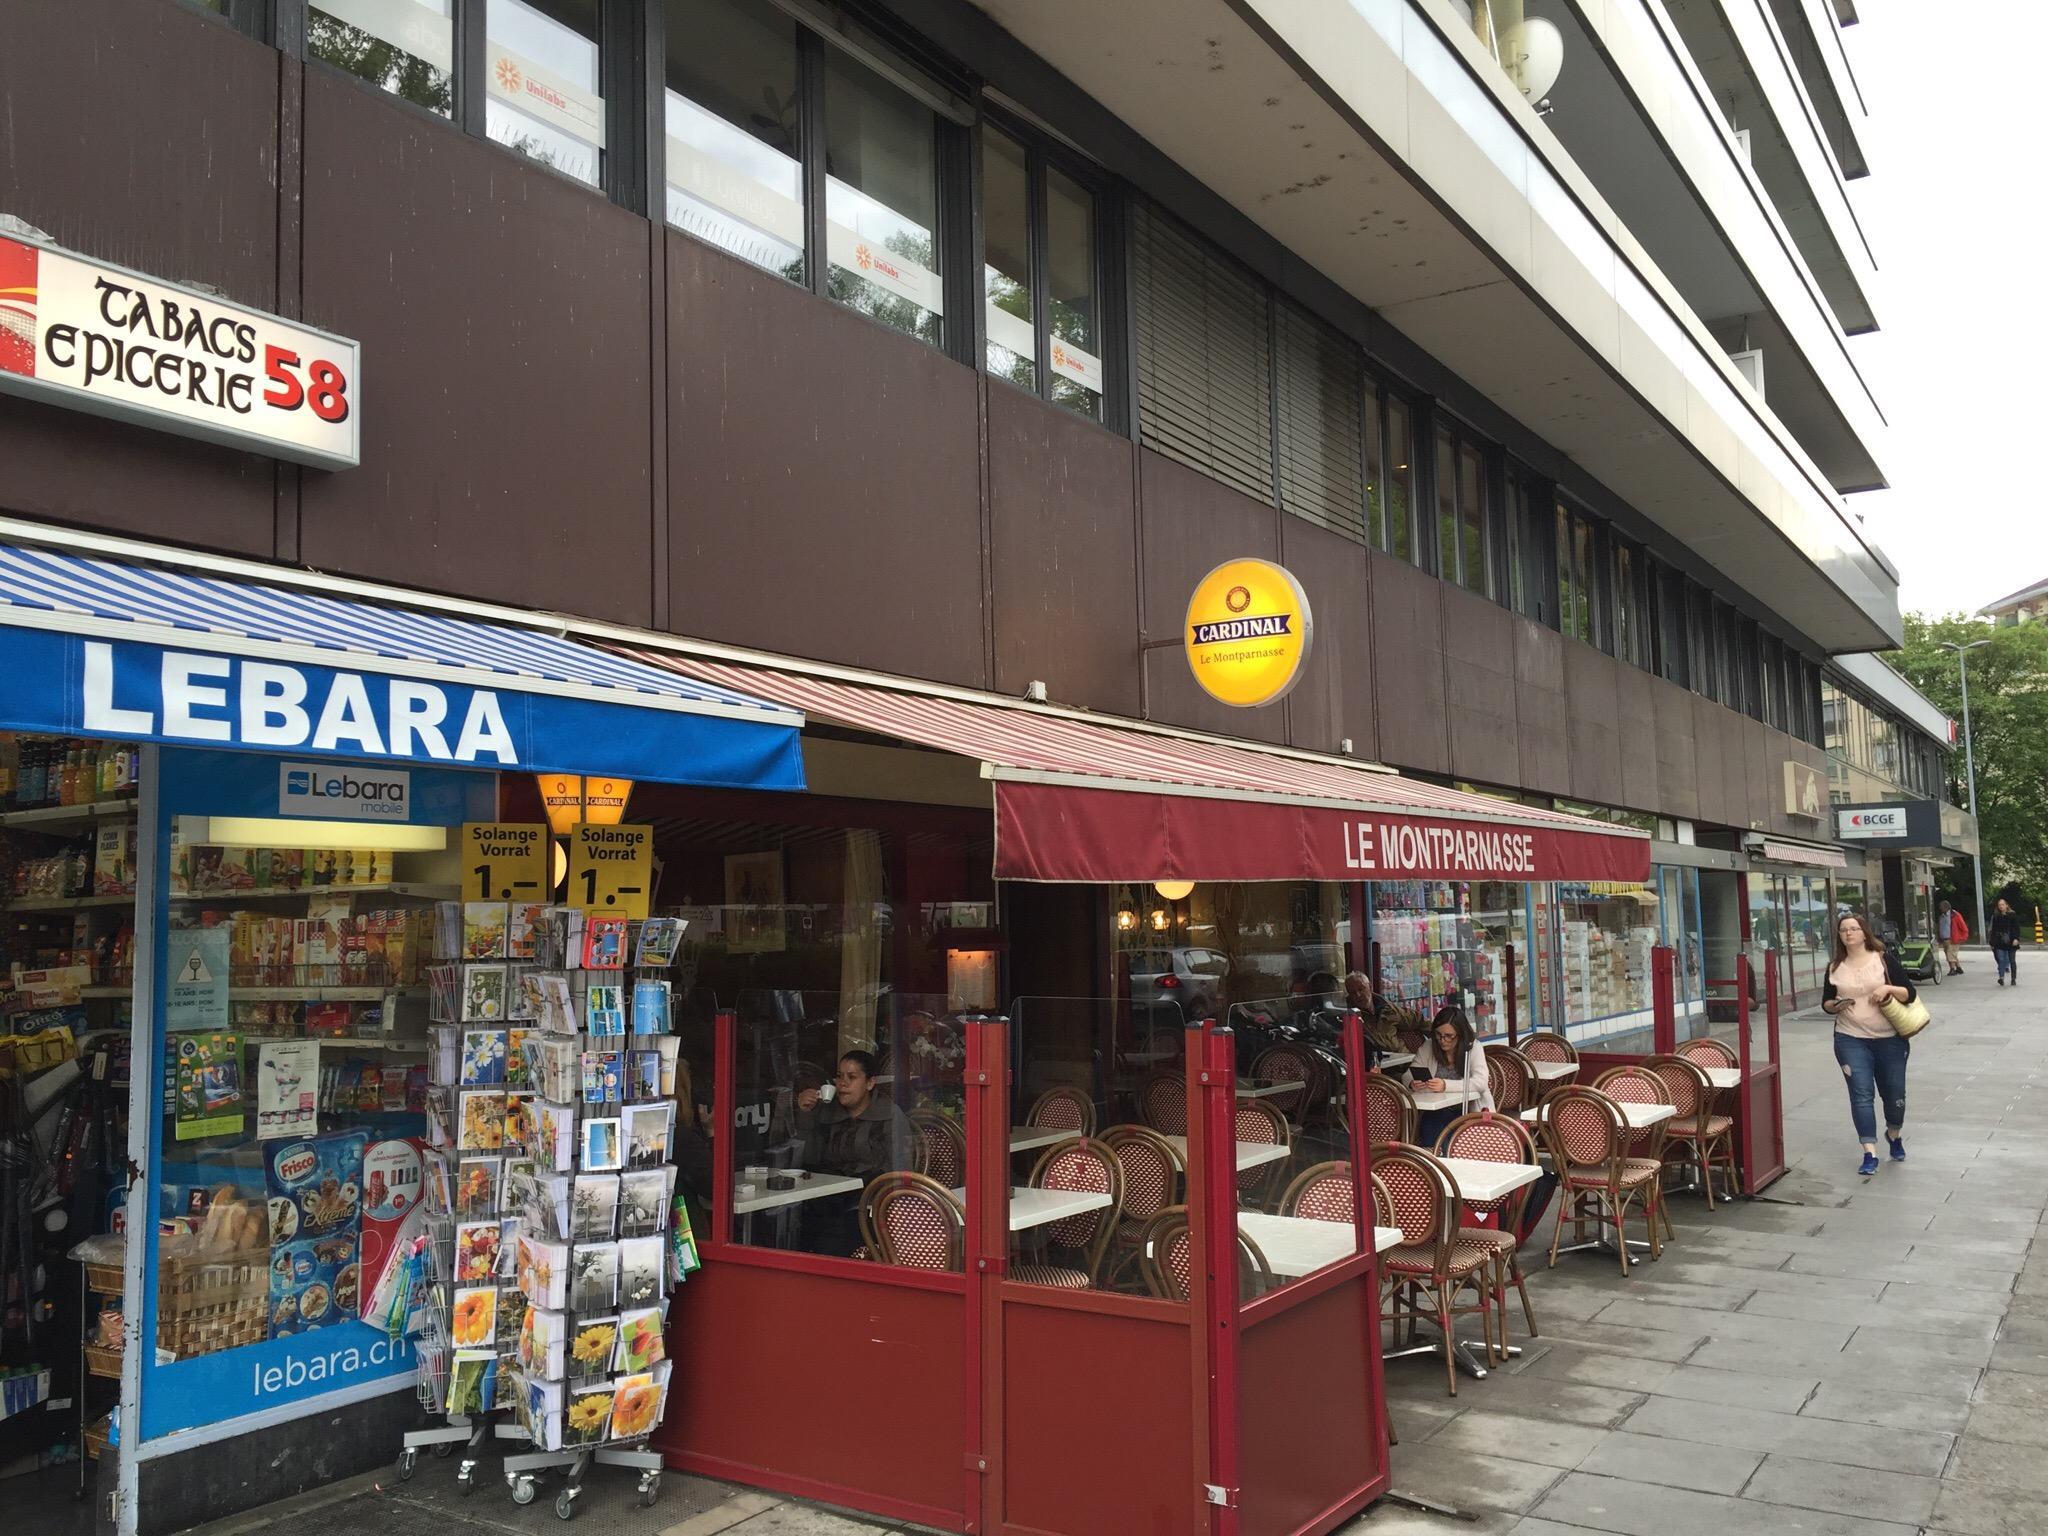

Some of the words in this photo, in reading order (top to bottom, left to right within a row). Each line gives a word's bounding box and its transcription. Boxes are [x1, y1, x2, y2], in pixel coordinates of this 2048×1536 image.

[525, 78, 567, 109] Unilabs
[874, 258, 899, 279] Unilabs
[94, 276, 257, 364] TABACS
[44, 323, 256, 415] EPICERIE
[263, 343, 349, 424] 58
[1199, 617, 1286, 643] CARDINAL
[1200, 654, 1211, 665] Le
[1213, 647, 1285, 663] Montparnasse
[83, 640, 519, 765] LEBARA
[312, 772, 403, 802] Lebara
[361, 802, 404, 815] mobile
[548, 797, 579, 806] CARDINAL
[589, 797, 622, 806] CARDINAL
[1863, 814, 1896, 825] BCGE
[472, 827, 538, 844] Solange
[581, 827, 644, 847] Solange
[480, 843, 531, 857] Vorrat
[588, 845, 637, 861] Vorrat
[1343, 821, 1376, 869] LE
[1379, 824, 1535, 873] MONTPARNASSE
[280, 1156, 315, 1178] Frisco
[254, 1337, 406, 1397] lebara.ch
